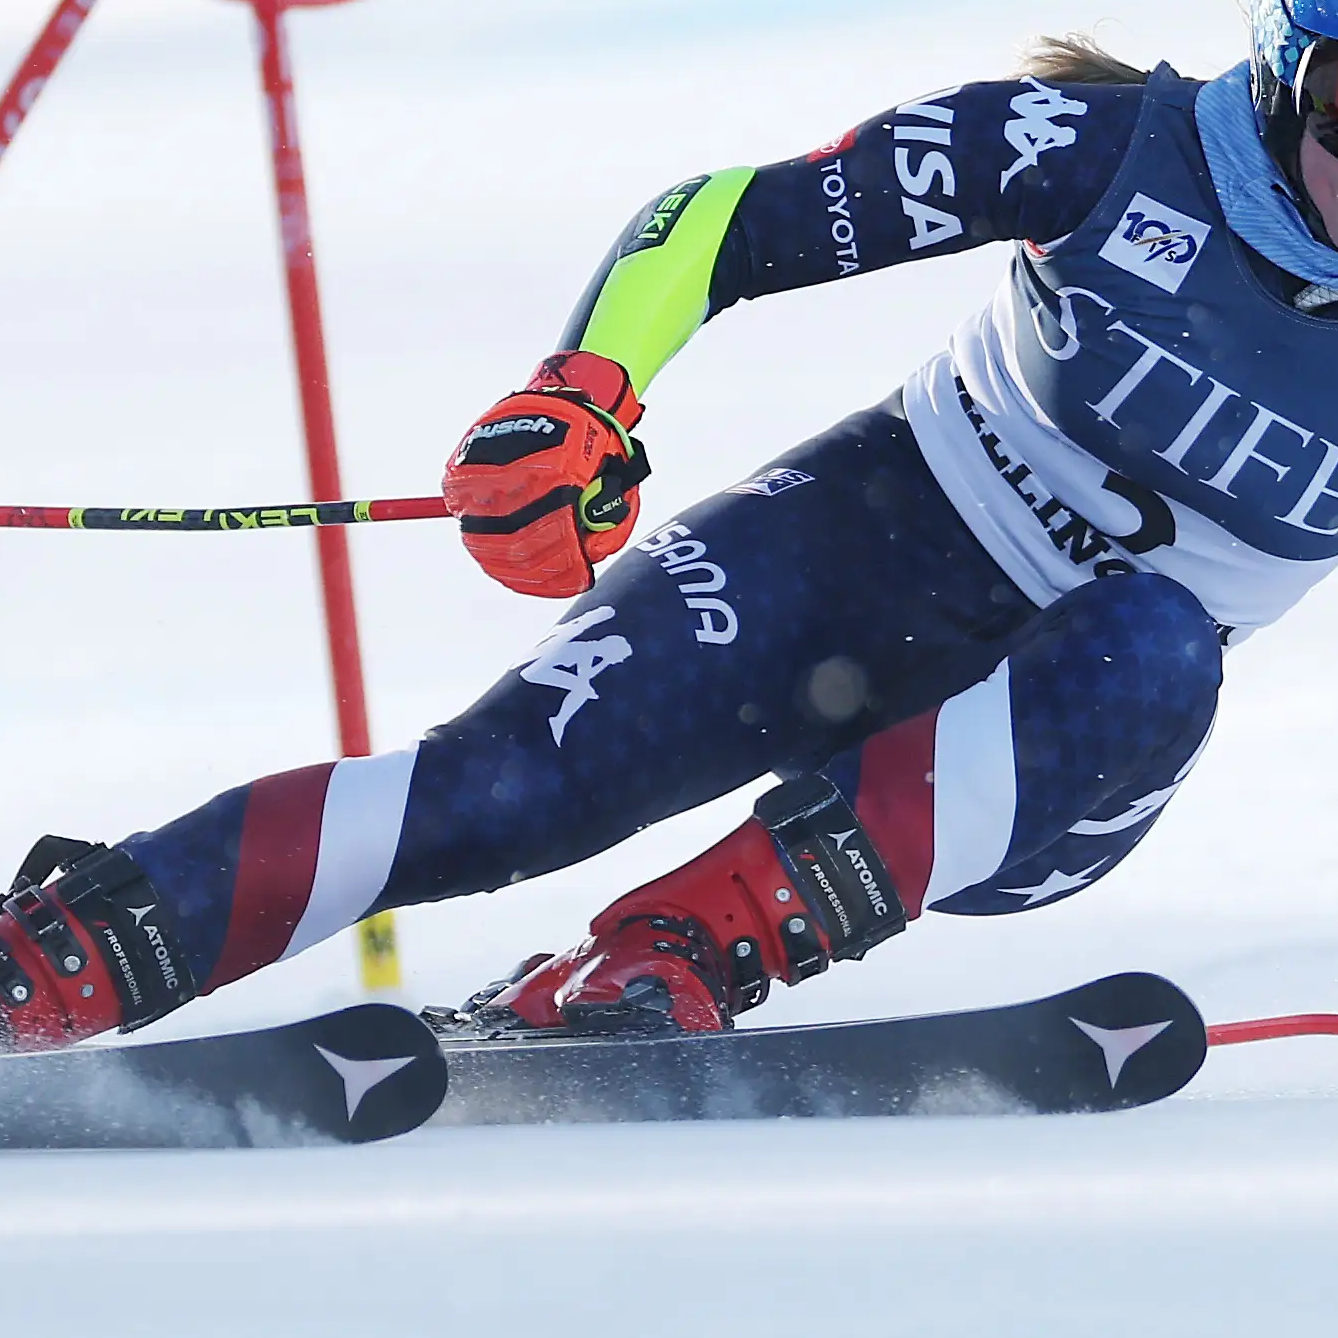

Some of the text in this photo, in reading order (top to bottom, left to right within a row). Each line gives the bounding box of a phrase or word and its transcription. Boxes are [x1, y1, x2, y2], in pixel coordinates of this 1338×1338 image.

[894, 85, 963, 250] VISA
[636, 178, 703, 240] LEKI
[820, 158, 860, 276] TOYOTA
[220, 507, 321, 531] LEKI
[592, 496, 623, 516] LEKI
[635, 520, 739, 645] SANA
[810, 863, 852, 937] PROFESSIONAL
[845, 849, 888, 916] ATOMIC
[103, 927, 143, 1005] PROFESSIONAL
[143, 925, 178, 989] ATOMIC
